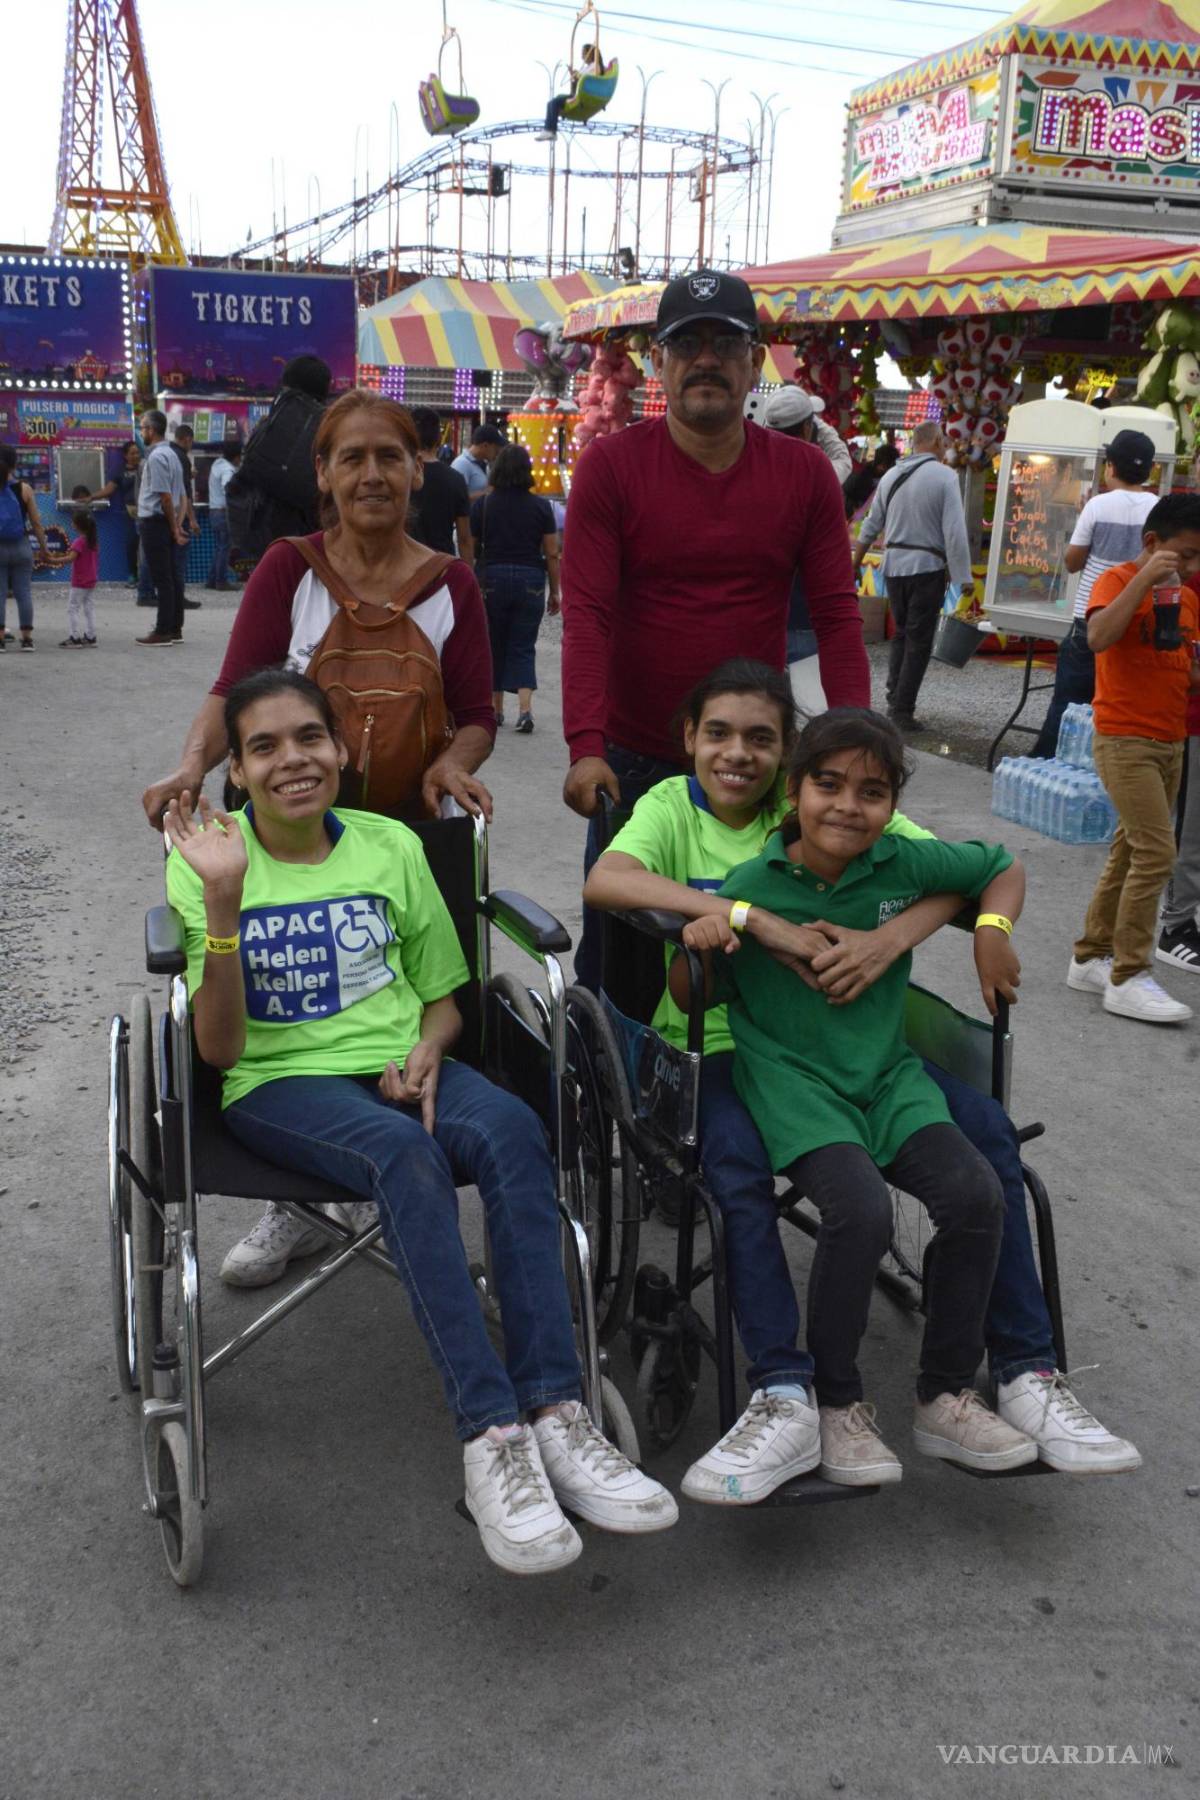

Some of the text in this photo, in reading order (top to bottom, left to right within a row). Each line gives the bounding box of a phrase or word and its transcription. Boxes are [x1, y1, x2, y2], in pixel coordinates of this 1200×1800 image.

[1037, 91, 1200, 158] mas
[191, 290, 312, 325] TICKETS
[22, 400, 115, 415] PULSERA MAGICA
[244, 910, 325, 942] APAC
[248, 944, 327, 969] Helen
[252, 970, 330, 992] Keller
[266, 992, 328, 1016] A. C.
